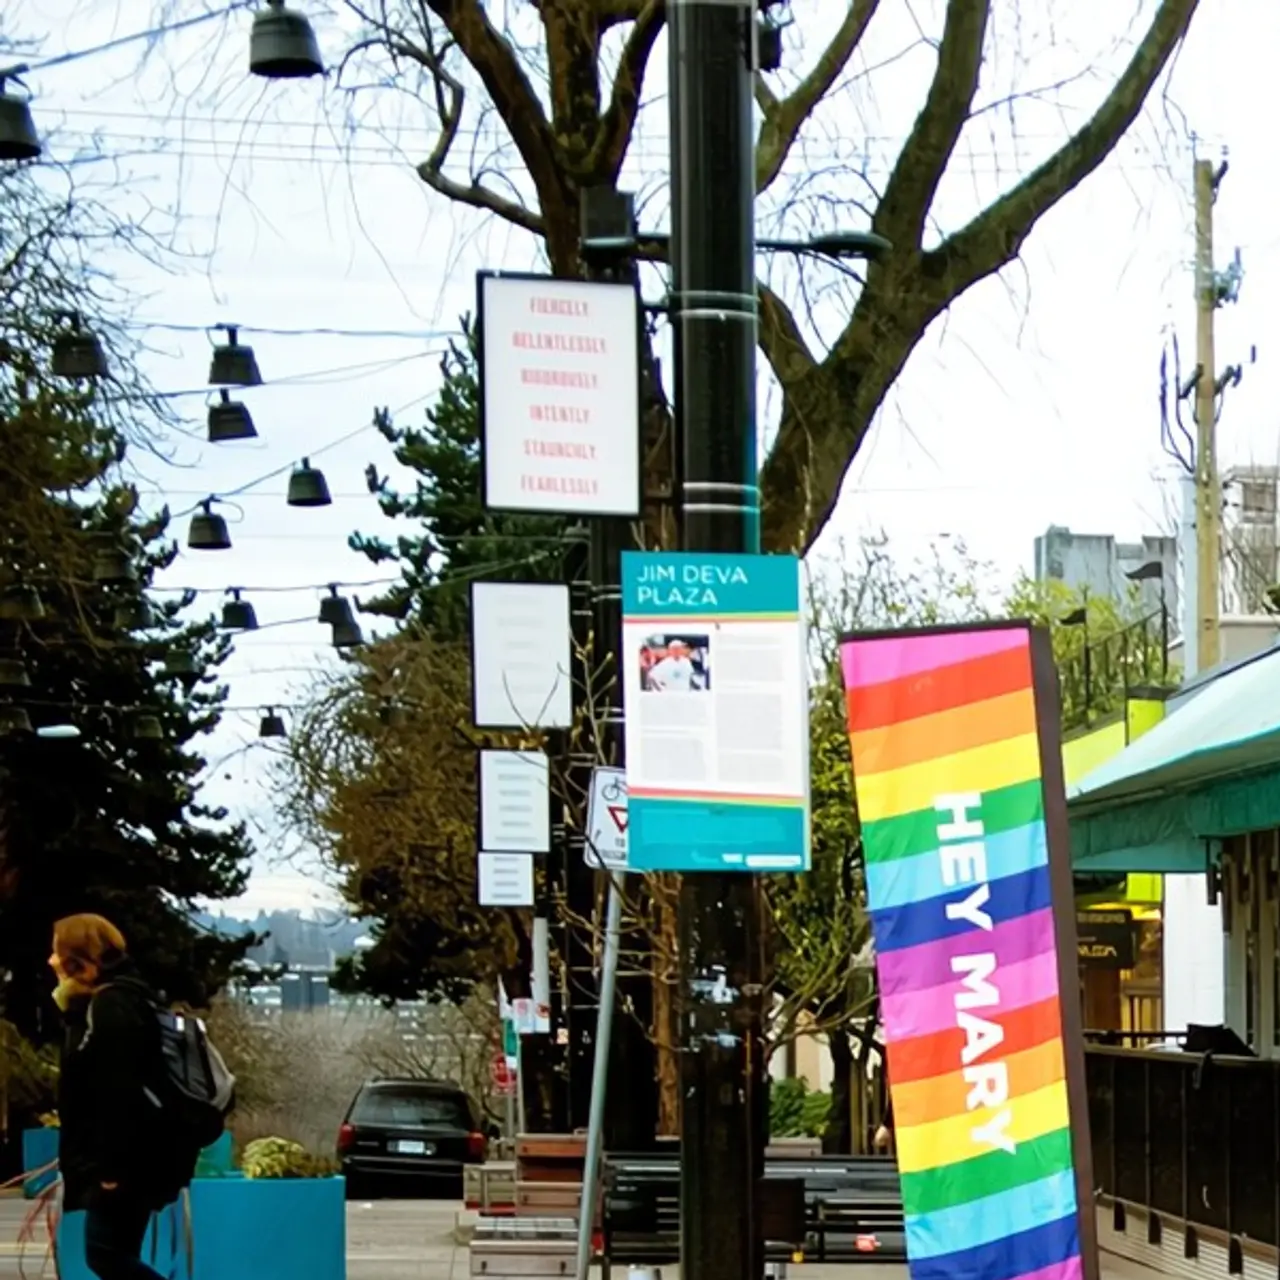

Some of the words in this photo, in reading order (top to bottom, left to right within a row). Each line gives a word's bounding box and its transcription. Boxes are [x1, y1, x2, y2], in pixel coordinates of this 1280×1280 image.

[636, 565, 676, 583] JIM
[682, 564, 749, 585] DEVA
[637, 585, 719, 606] PLAZA
[933, 792, 994, 932] HEY
[951, 952, 1017, 1156] MARY
